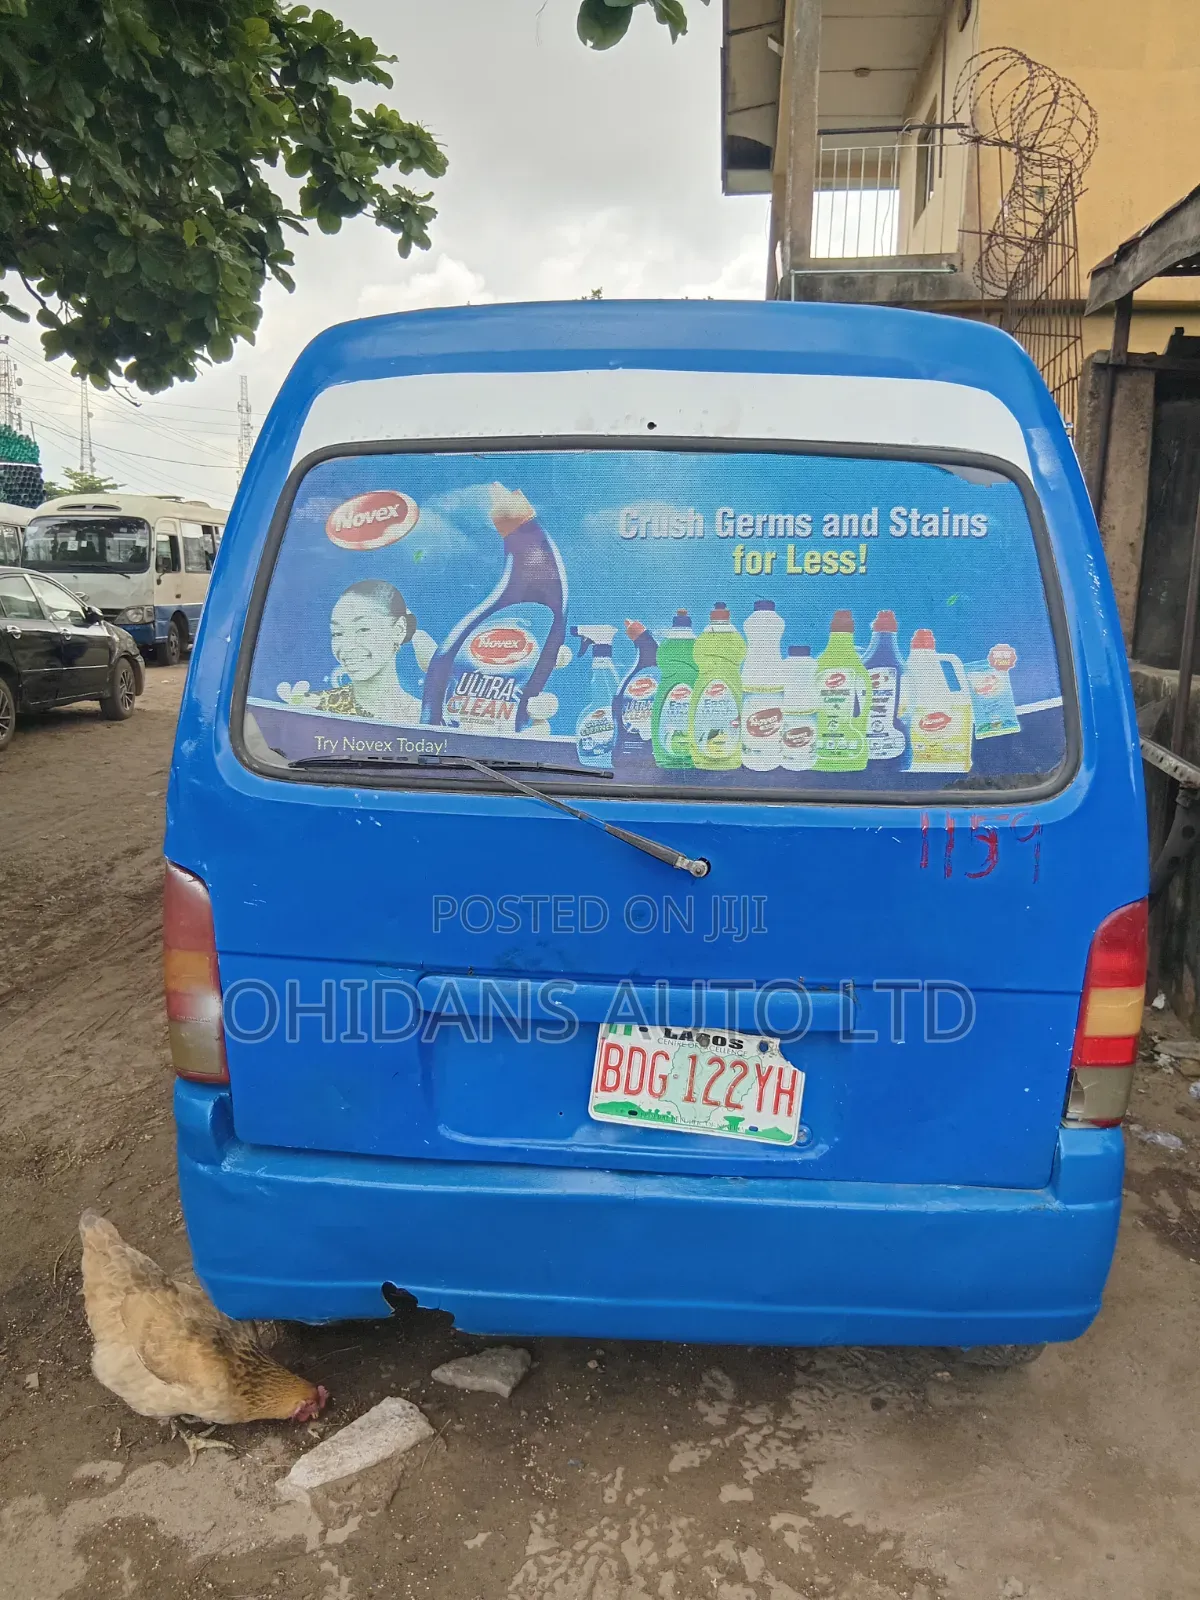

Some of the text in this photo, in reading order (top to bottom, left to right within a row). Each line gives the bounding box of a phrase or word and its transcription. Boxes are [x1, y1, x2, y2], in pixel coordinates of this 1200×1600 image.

[334, 503, 400, 532] Novex
[617, 506, 989, 539] Crush Germs and Stains
[732, 543, 868, 575] for Less!
[478, 634, 519, 649] Novex
[456, 672, 516, 701] ULTRA
[447, 695, 515, 720] CLEAN
[314, 735, 448, 756] Try Novex Today!
[599, 1042, 670, 1099] BDG
